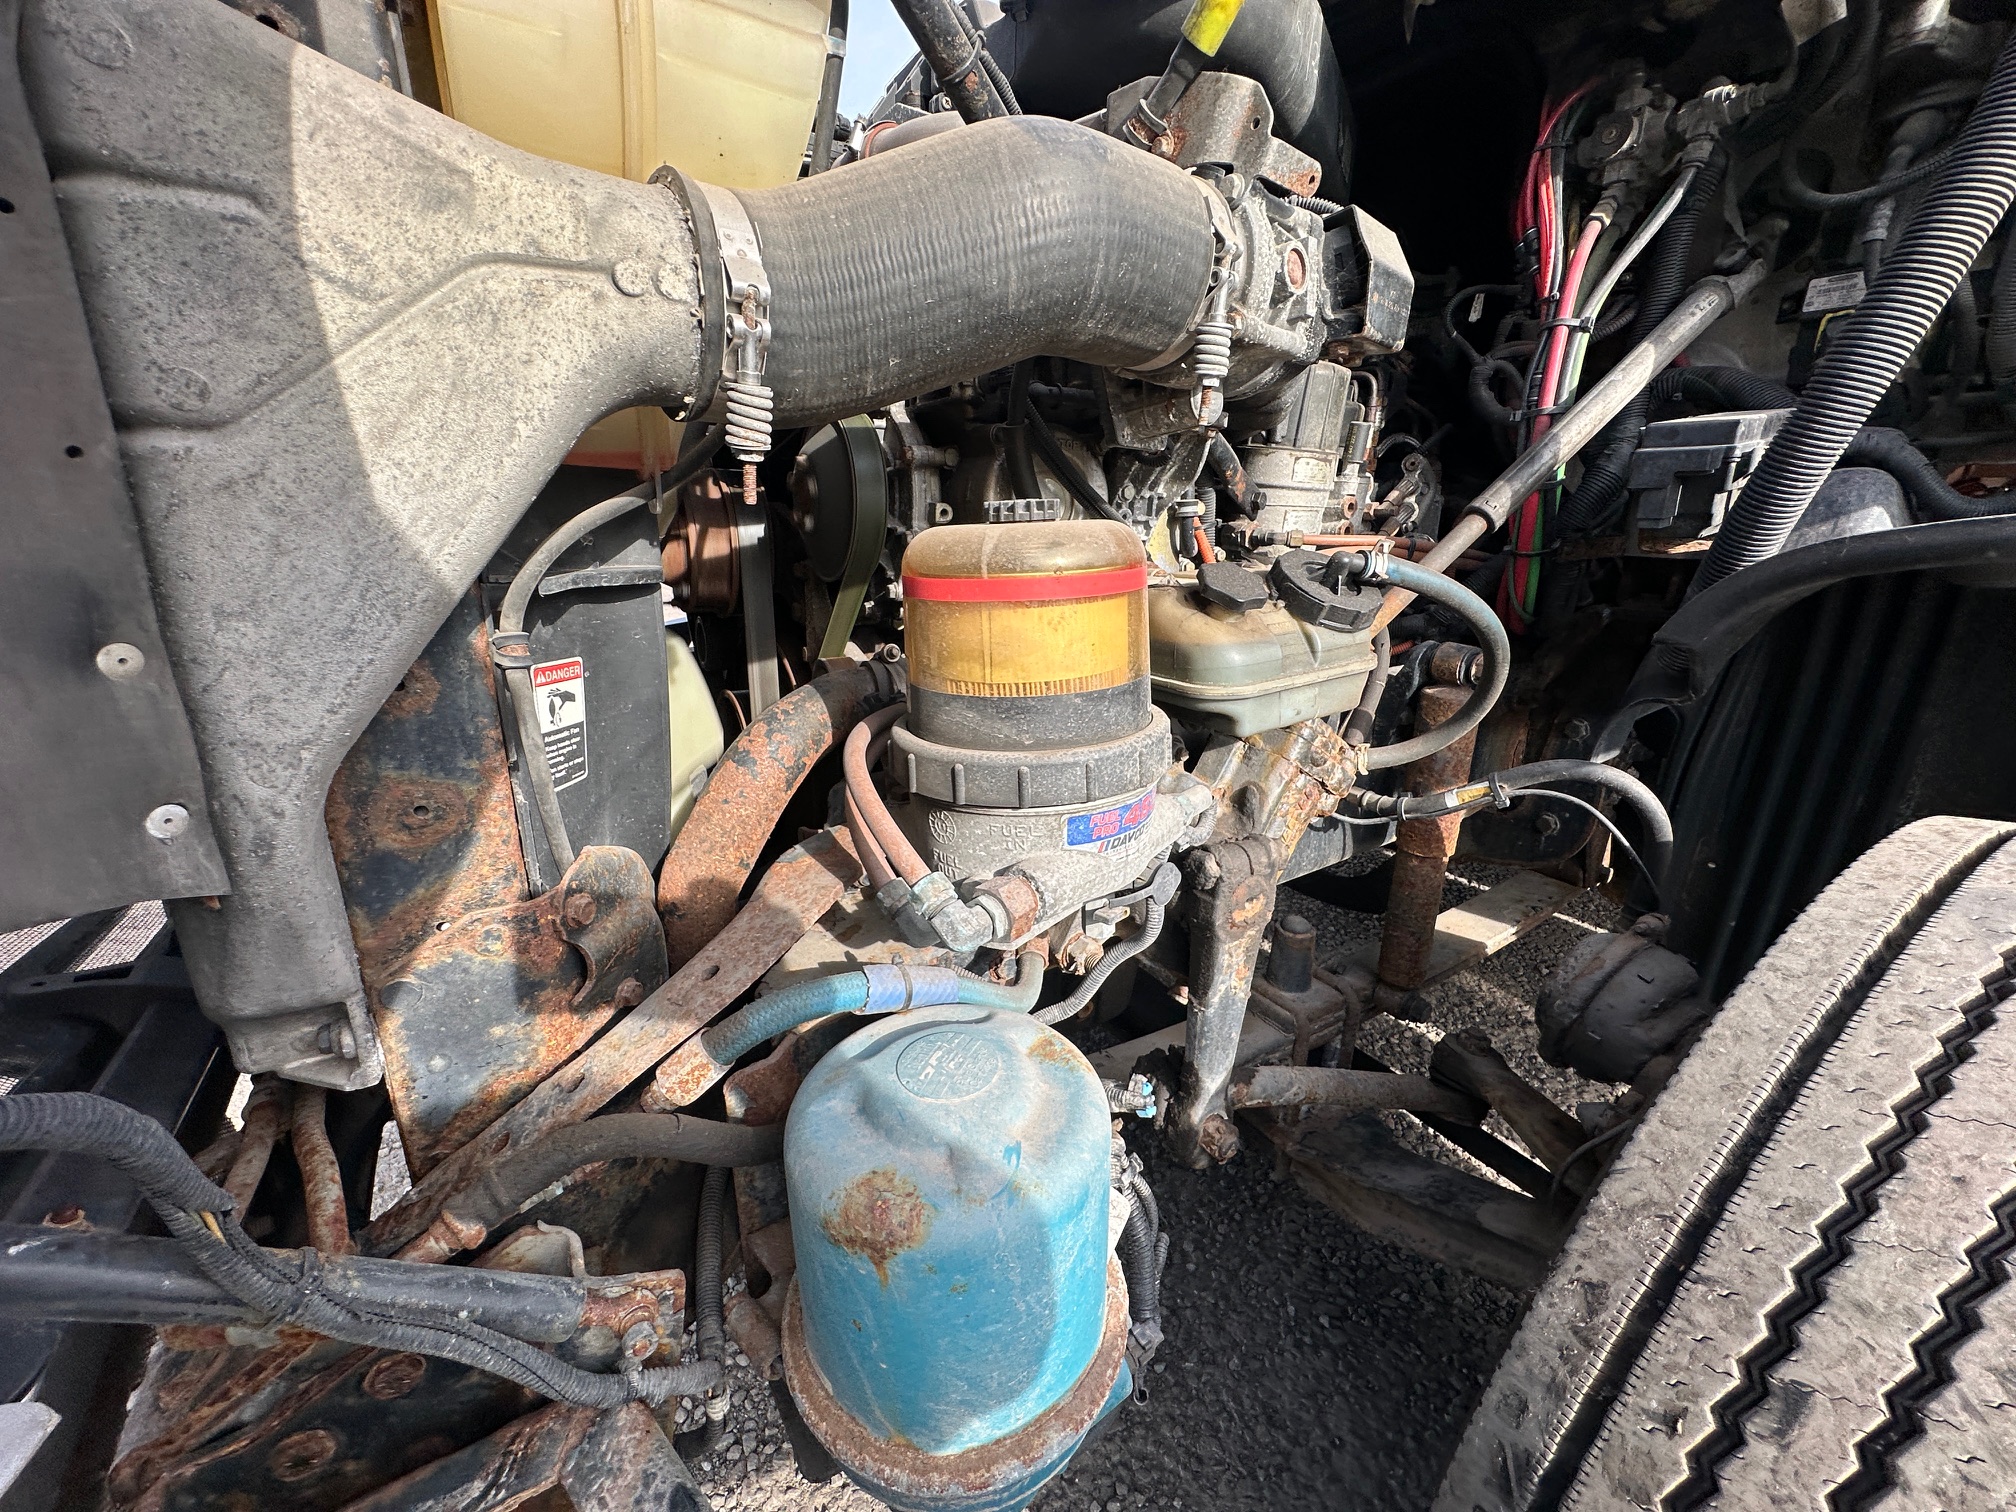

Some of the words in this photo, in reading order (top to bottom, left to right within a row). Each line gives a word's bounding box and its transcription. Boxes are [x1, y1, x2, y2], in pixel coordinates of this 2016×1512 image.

[545, 665, 581, 682] DANGER
[544, 730, 570, 743] Automatic
[570, 727, 580, 735] Fan
[1089, 809, 1121, 828] FUEL
[988, 823, 1044, 838] FUEL
[1092, 821, 1120, 839] PRO
[1004, 839, 1027, 852] IN
[932, 847, 959, 869] FUEL
